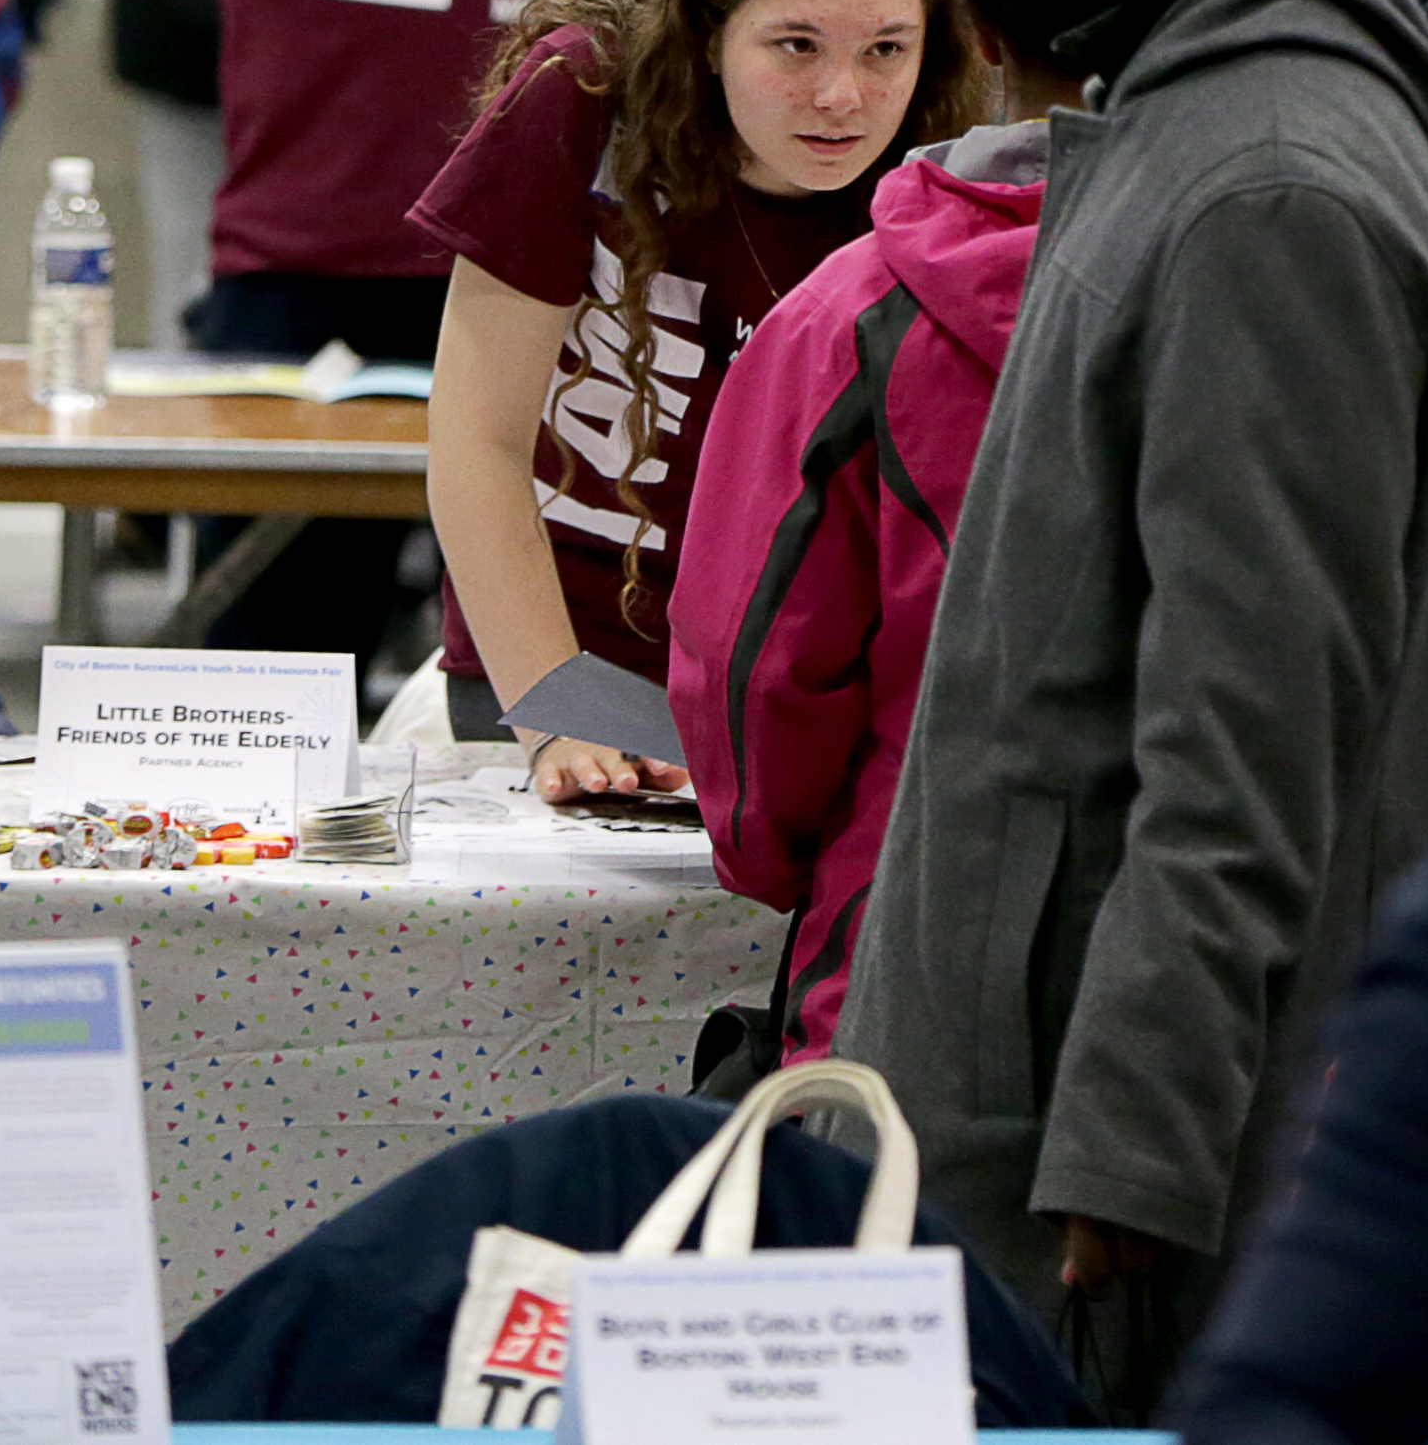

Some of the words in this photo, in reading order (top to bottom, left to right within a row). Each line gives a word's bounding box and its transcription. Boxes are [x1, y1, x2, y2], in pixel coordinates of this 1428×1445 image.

[53, 660, 75, 671] City
[78, 661, 89, 671] of
[92, 662, 129, 671] Boston
[202, 664, 233, 674] Youth
[236, 665, 256, 675] Job
[259, 666, 266, 675] &
[322, 667, 342, 676] Fair
[96, 704, 163, 722] LITTLE
[173, 706, 293, 725] BROTHERS-
[57, 727, 146, 745] FRIENDS
[155, 732, 183, 746] OF
[190, 733, 229, 747] THE
[238, 731, 332, 750] ELDERLY
